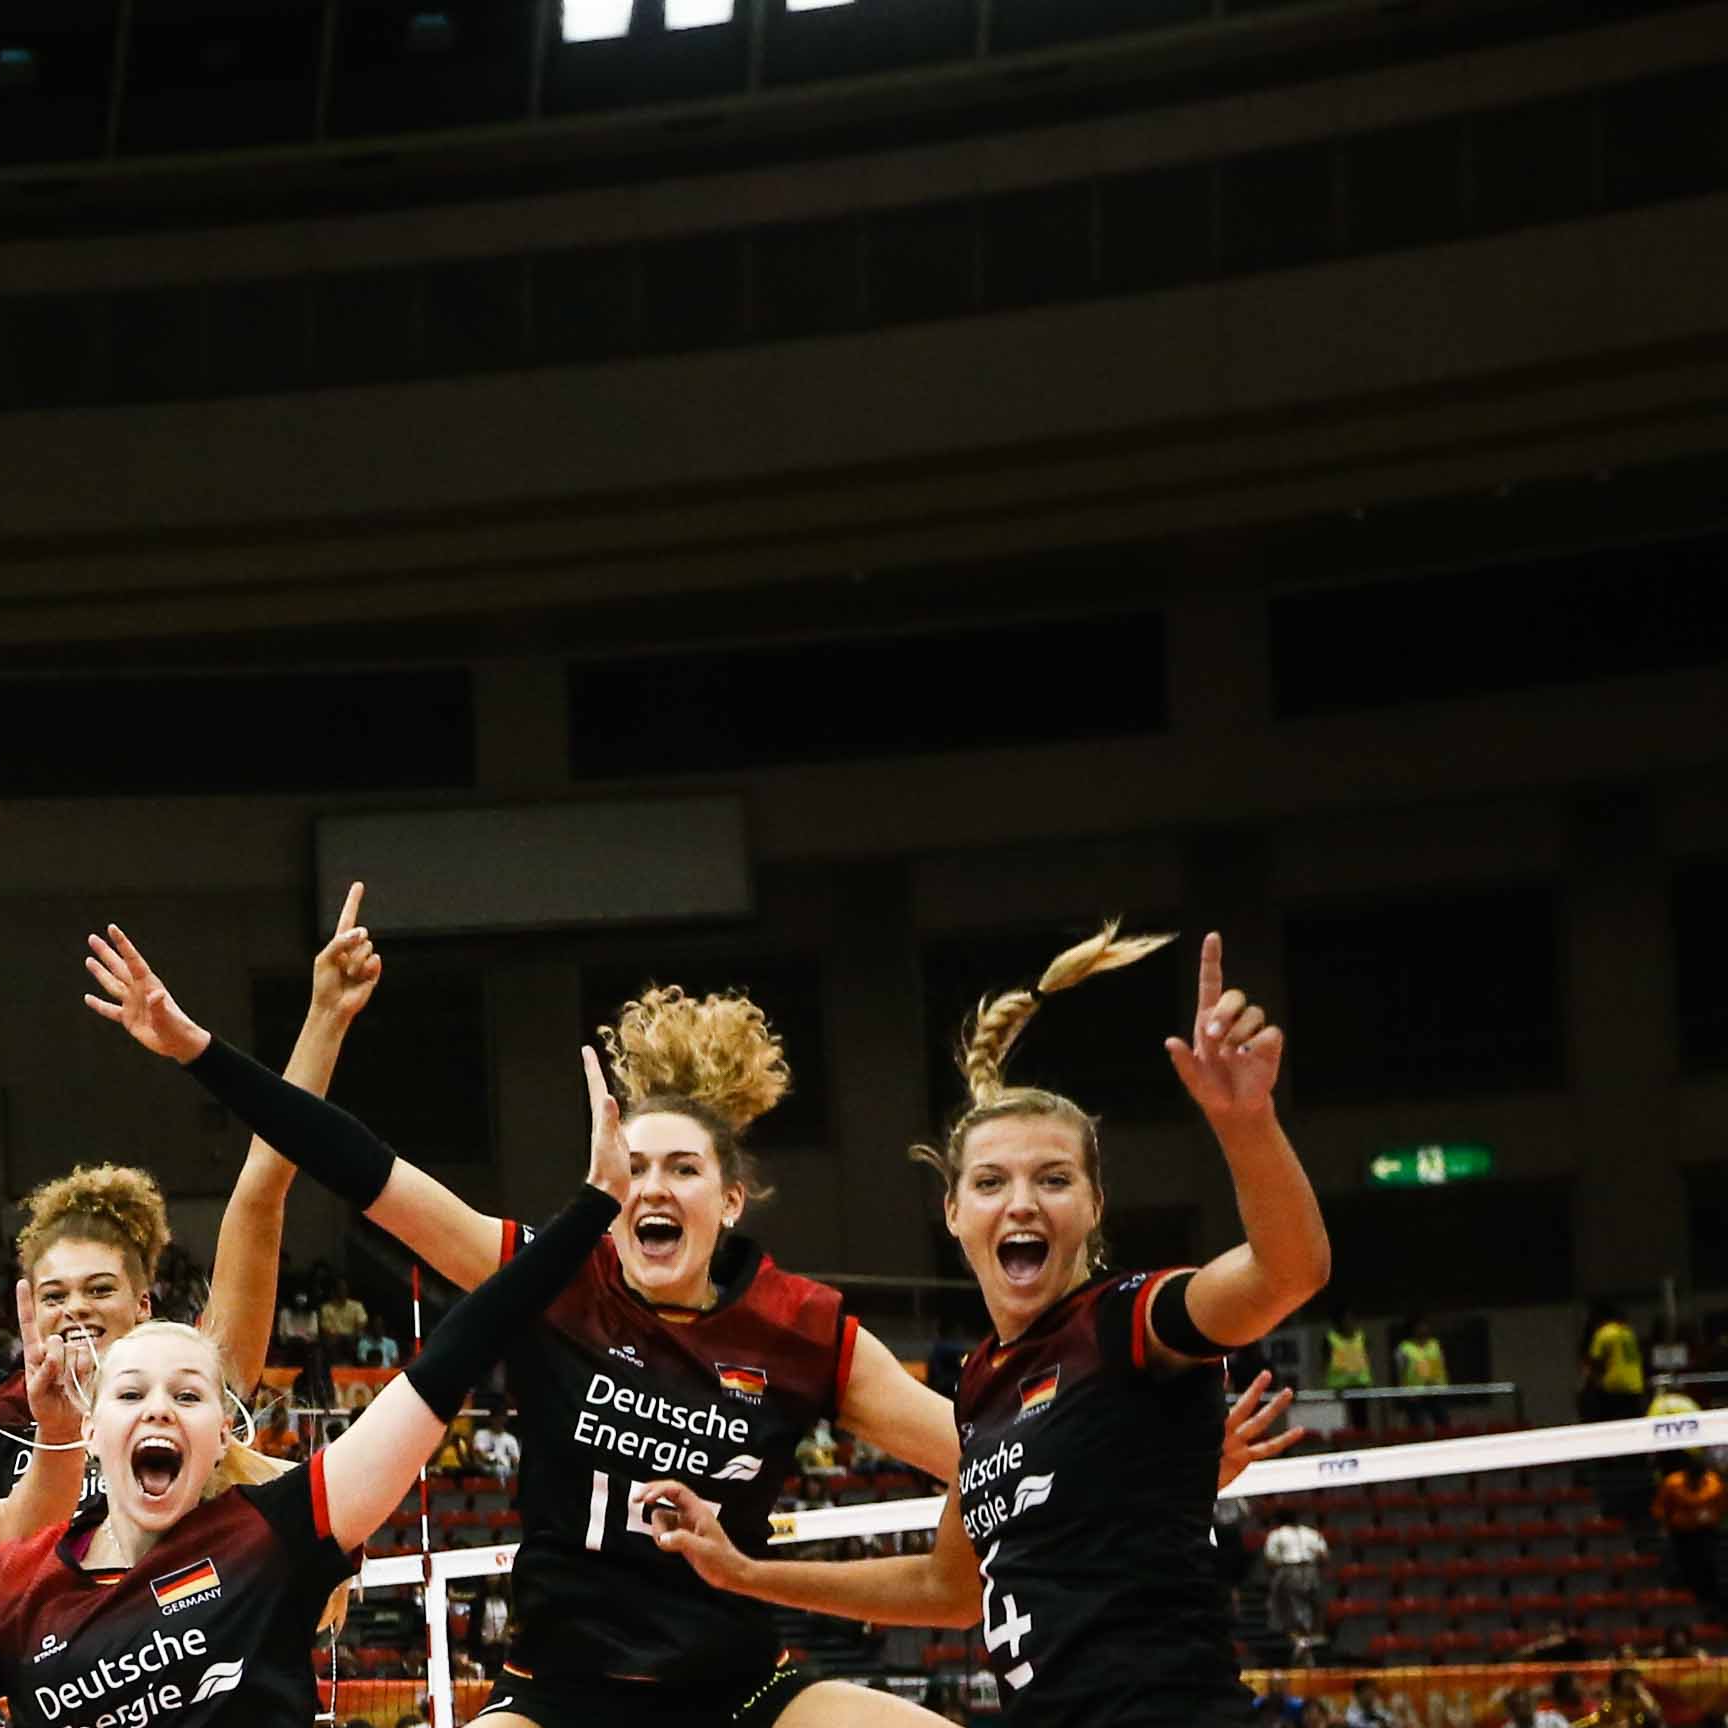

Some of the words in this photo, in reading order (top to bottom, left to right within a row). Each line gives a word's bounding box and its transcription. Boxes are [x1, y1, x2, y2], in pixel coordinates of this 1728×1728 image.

[586, 1373, 749, 1443] Deutsche
[574, 1411, 709, 1475] Energie
[161, 1587, 223, 1617] GERMANY
[34, 1628, 207, 1720] Deutsche
